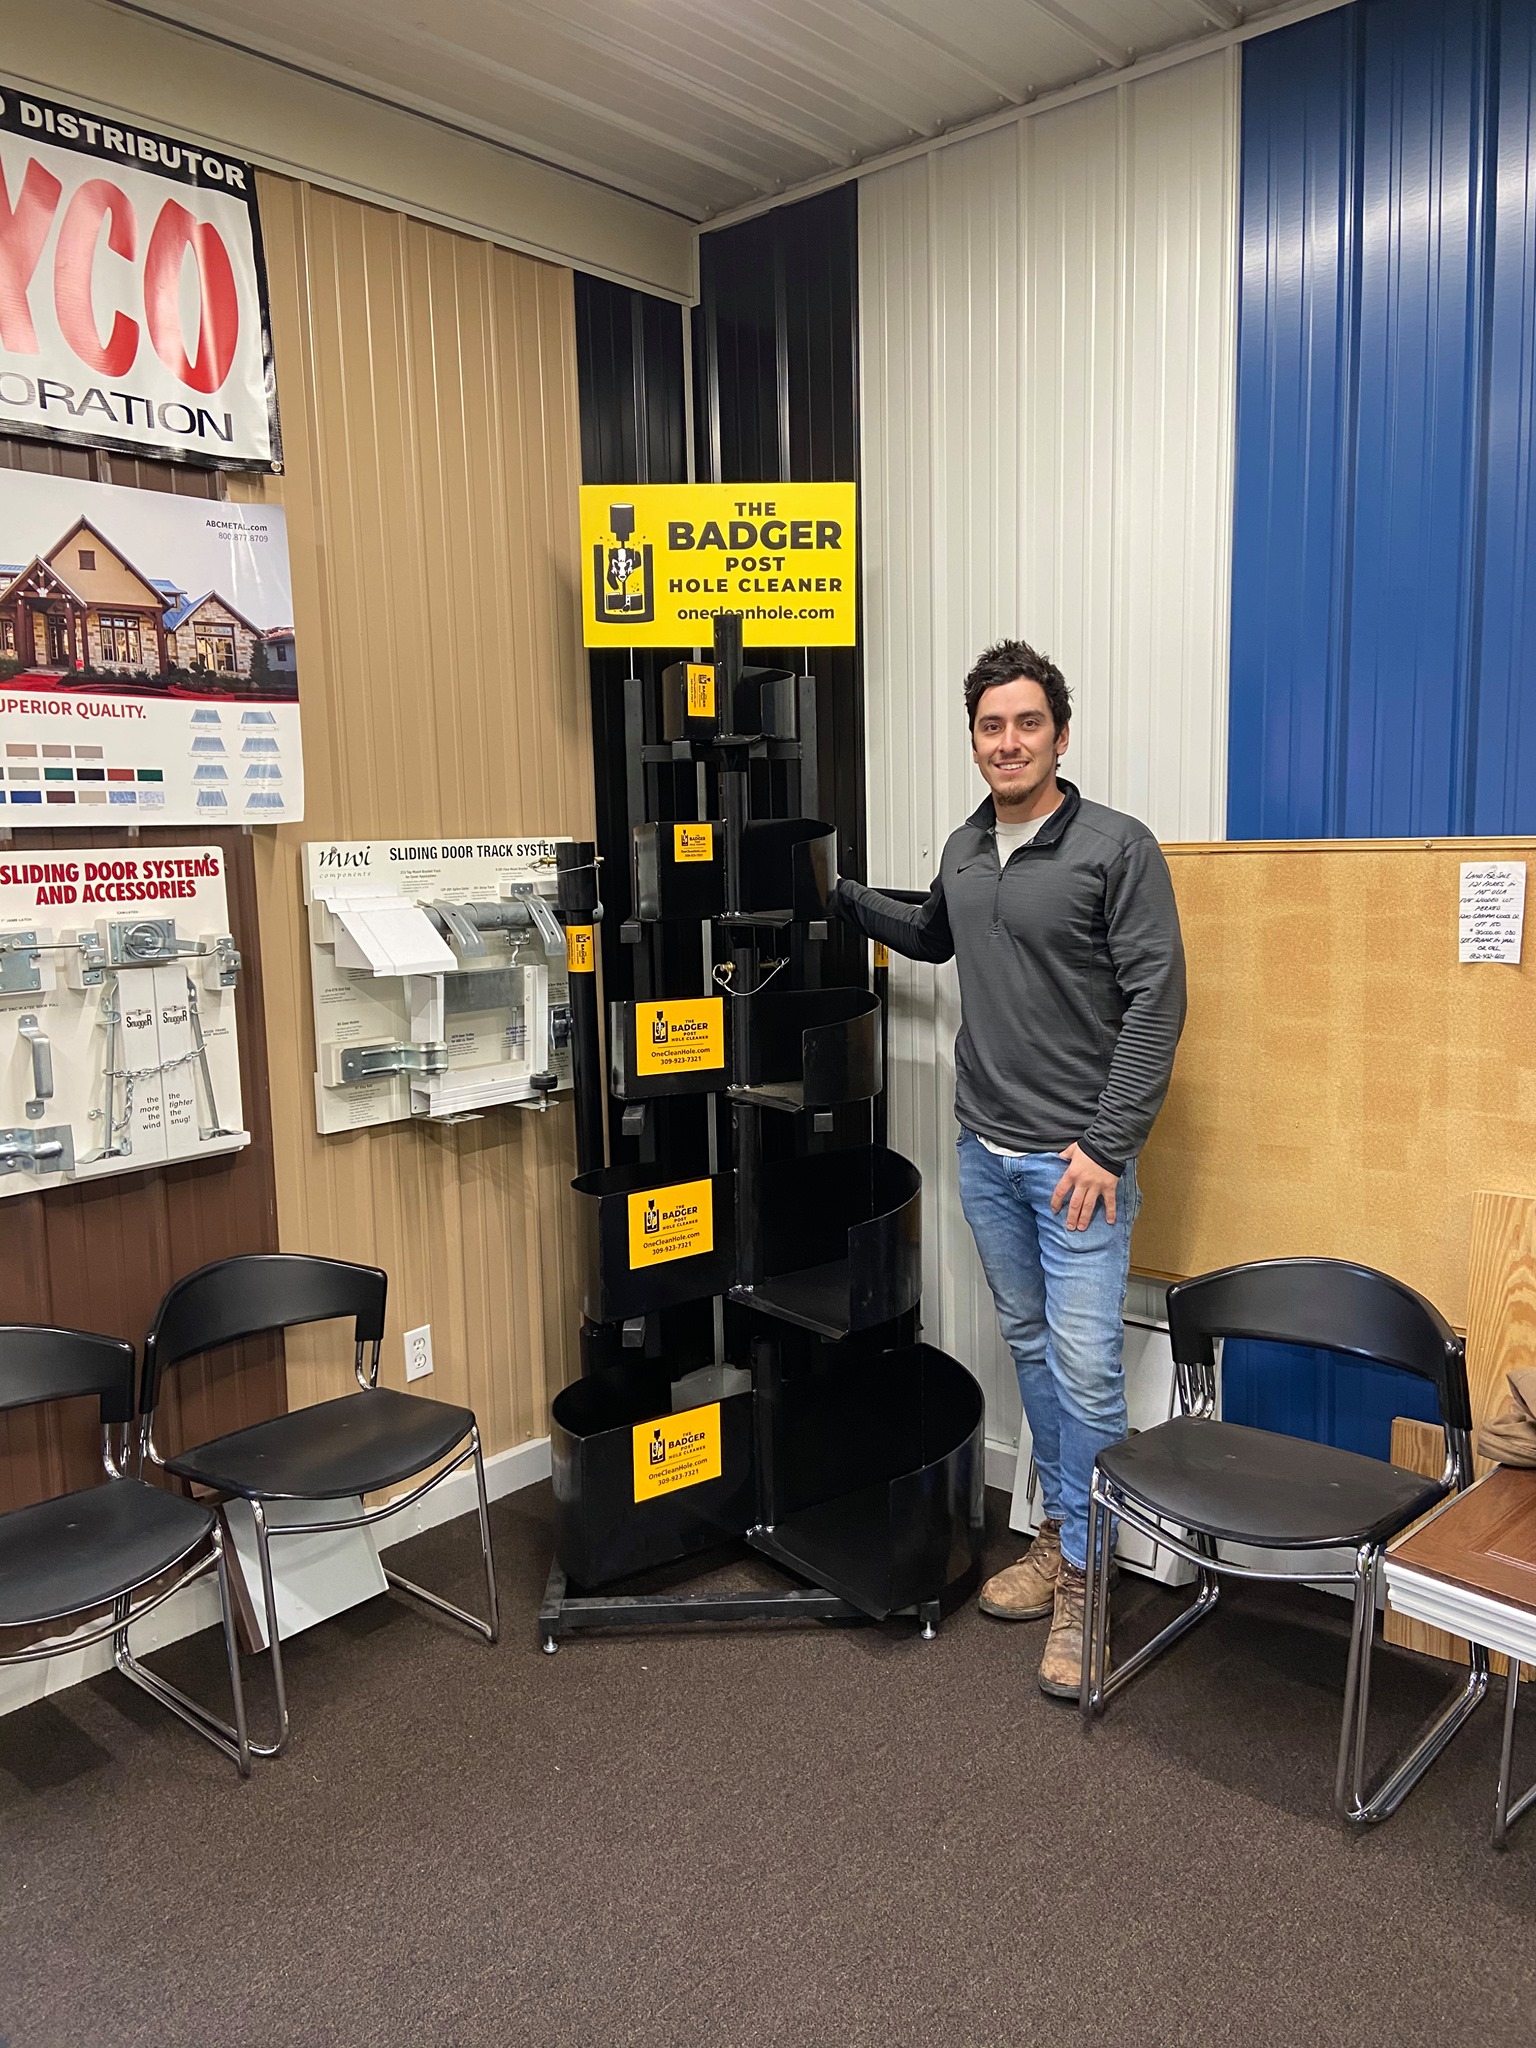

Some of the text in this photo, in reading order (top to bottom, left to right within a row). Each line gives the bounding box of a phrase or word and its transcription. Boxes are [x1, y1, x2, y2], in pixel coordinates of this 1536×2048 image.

[20, 100, 247, 190] DISTRIBUTOR
[0, 372, 234, 442] ORATION
[734, 502, 776, 516] THE
[206, 519, 268, 532] ABCMETAL.com
[668, 520, 842, 550] BADGER
[725, 556, 786, 572] POST
[670, 577, 842, 593] HOLE CLEANER
[76, 702, 147, 719] QUALITY.
[319, 845, 373, 868] mwi
[390, 846, 438, 861] SLIDING
[441, 845, 473, 859] DOOR
[477, 844, 513, 858] TRACK
[0, 859, 220, 885] SLIDING DOOR SYSTEMS
[319, 871, 372, 880] components
[36, 879, 197, 905] AND ACCESSORIES
[671, 1023, 708, 1032] BADGER
[651, 1047, 711, 1058] OneCleanHole.com
[660, 1056, 702, 1065] 309-923-7321
[146, 1096, 159, 1104] the
[169, 1099, 193, 1109] tighter
[140, 1105, 159, 1114] more
[148, 1113, 160, 1121] the
[170, 1116, 191, 1125] snug!
[143, 1121, 161, 1130] wind
[662, 1206, 698, 1220] BADGER
[676, 1219, 698, 1228] CLEANER
[643, 1231, 700, 1248] OneCleanHole.com
[652, 1241, 692, 1256] 309-923-7321
[668, 1432, 705, 1449] BADGER
[683, 1445, 706, 1455] CLEANER
[648, 1458, 708, 1480] OneCleanHole.com
[658, 1468, 699, 1486] 309-923-7321
